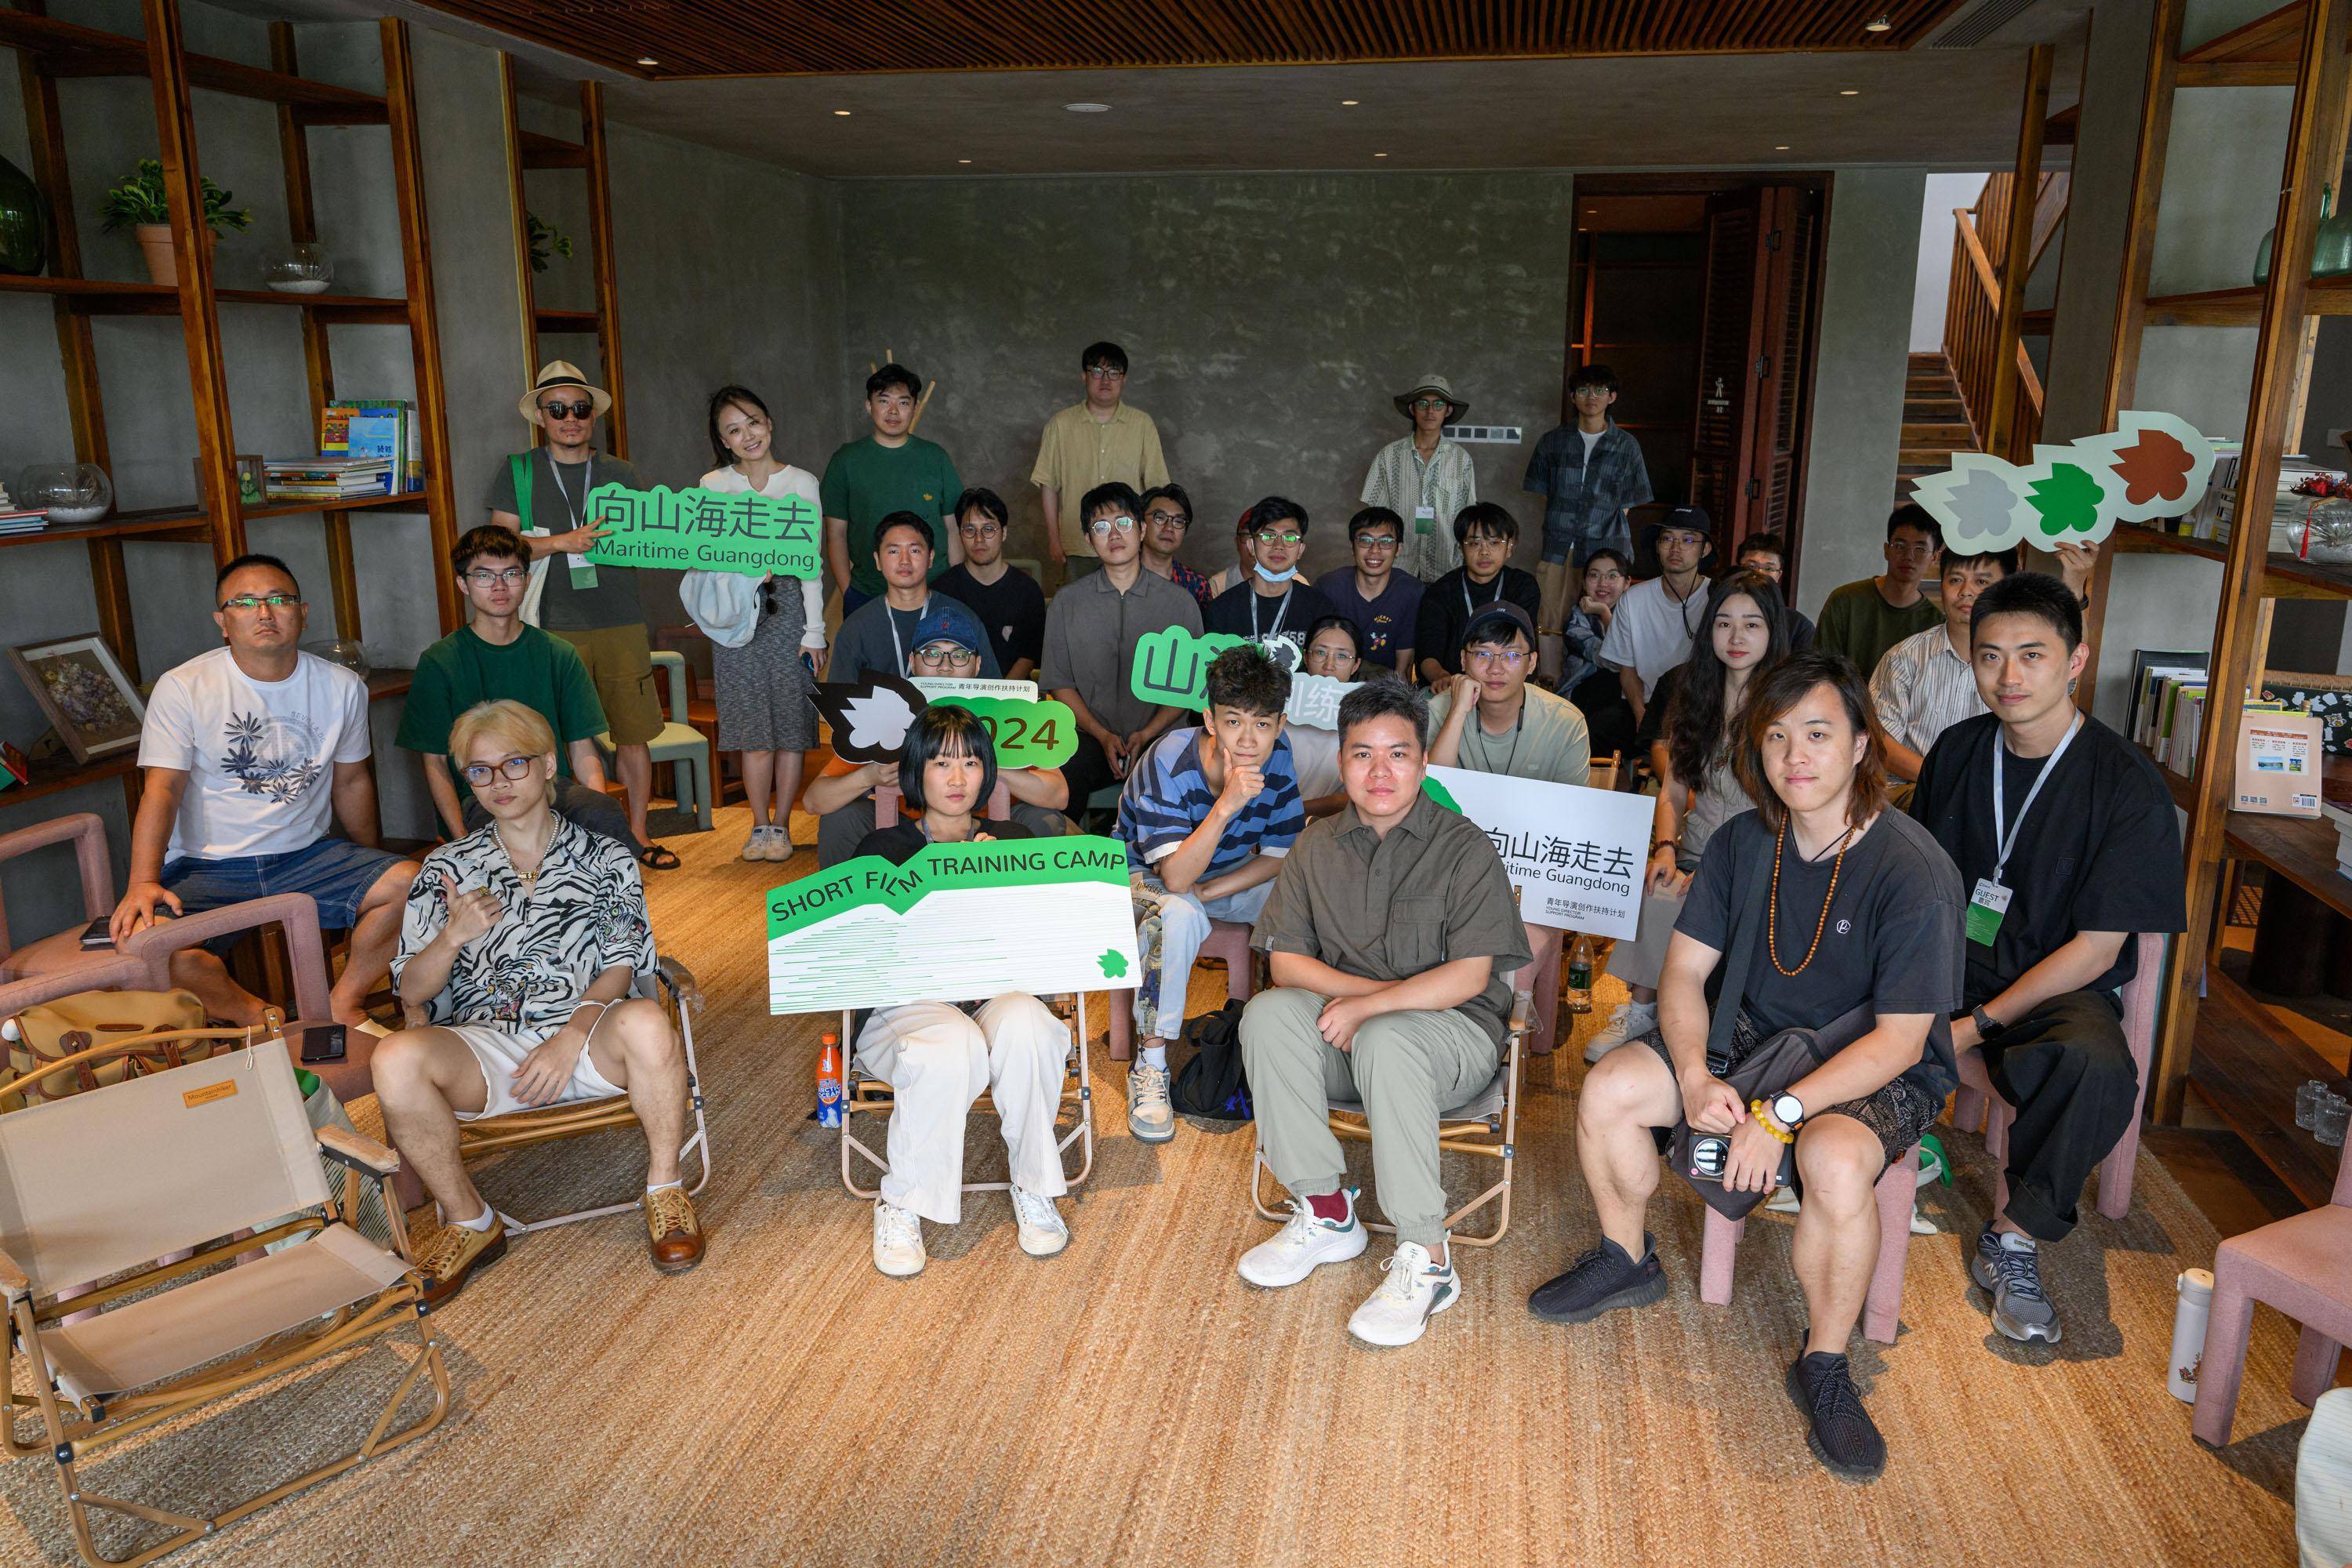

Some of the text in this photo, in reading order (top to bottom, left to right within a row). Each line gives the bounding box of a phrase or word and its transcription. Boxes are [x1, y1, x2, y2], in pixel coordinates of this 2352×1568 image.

[595, 488, 815, 543] 向山海走去
[595, 538, 815, 572] Maritime Guangdong
[1144, 638, 1221, 699] 山
[958, 683, 1031, 692] 青年导演创作扶持计划
[1485, 826, 1634, 879] 向山海走去
[771, 849, 1126, 923] SHORT FILM TRAINING CAMP
[1546, 869, 1630, 897] Guangdong
[1975, 888, 1999, 902] GUEST
[1547, 897, 1625, 919] 青年导演创作扶持计划
[818, 1083, 841, 1093] ARCTIC
[818, 1090, 841, 1098] OCEAN
